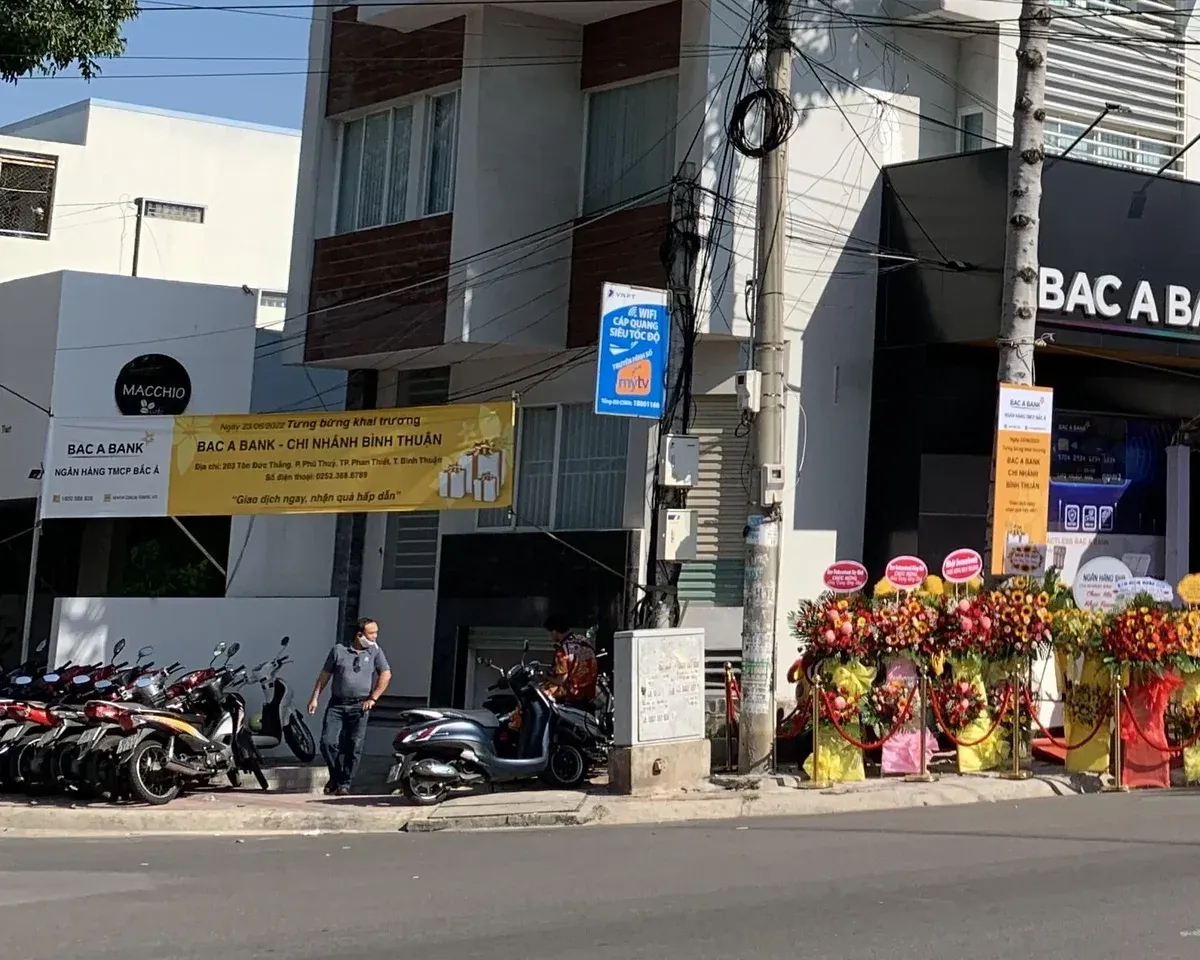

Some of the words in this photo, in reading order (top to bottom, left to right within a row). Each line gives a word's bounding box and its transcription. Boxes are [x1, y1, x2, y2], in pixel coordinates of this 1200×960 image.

[1039, 267, 1122, 318] BAC
[1127, 280, 1159, 323] A
[639, 307, 657, 320] WIFI
[613, 316, 629, 327] CÁP
[630, 319, 659, 330] QUANG
[122, 384, 186, 399] MACCHIO
[1010, 399, 1021, 407] BAC
[1027, 400, 1040, 408] BANK
[220, 423, 240, 432] Ngày
[353, 417, 377, 427] khai
[197, 440, 224, 452] BAC
[227, 440, 236, 452] A
[239, 440, 275, 451] BANK
[287, 438, 309, 450] CHI
[362, 433, 393, 448] BÌNH
[397, 431, 443, 448] THUẬN
[68, 444, 93, 455] BAC
[96, 444, 105, 454] A
[108, 443, 144, 454] BANK
[1007, 456, 1019, 465] BAC
[108, 466, 131, 475] TMCP
